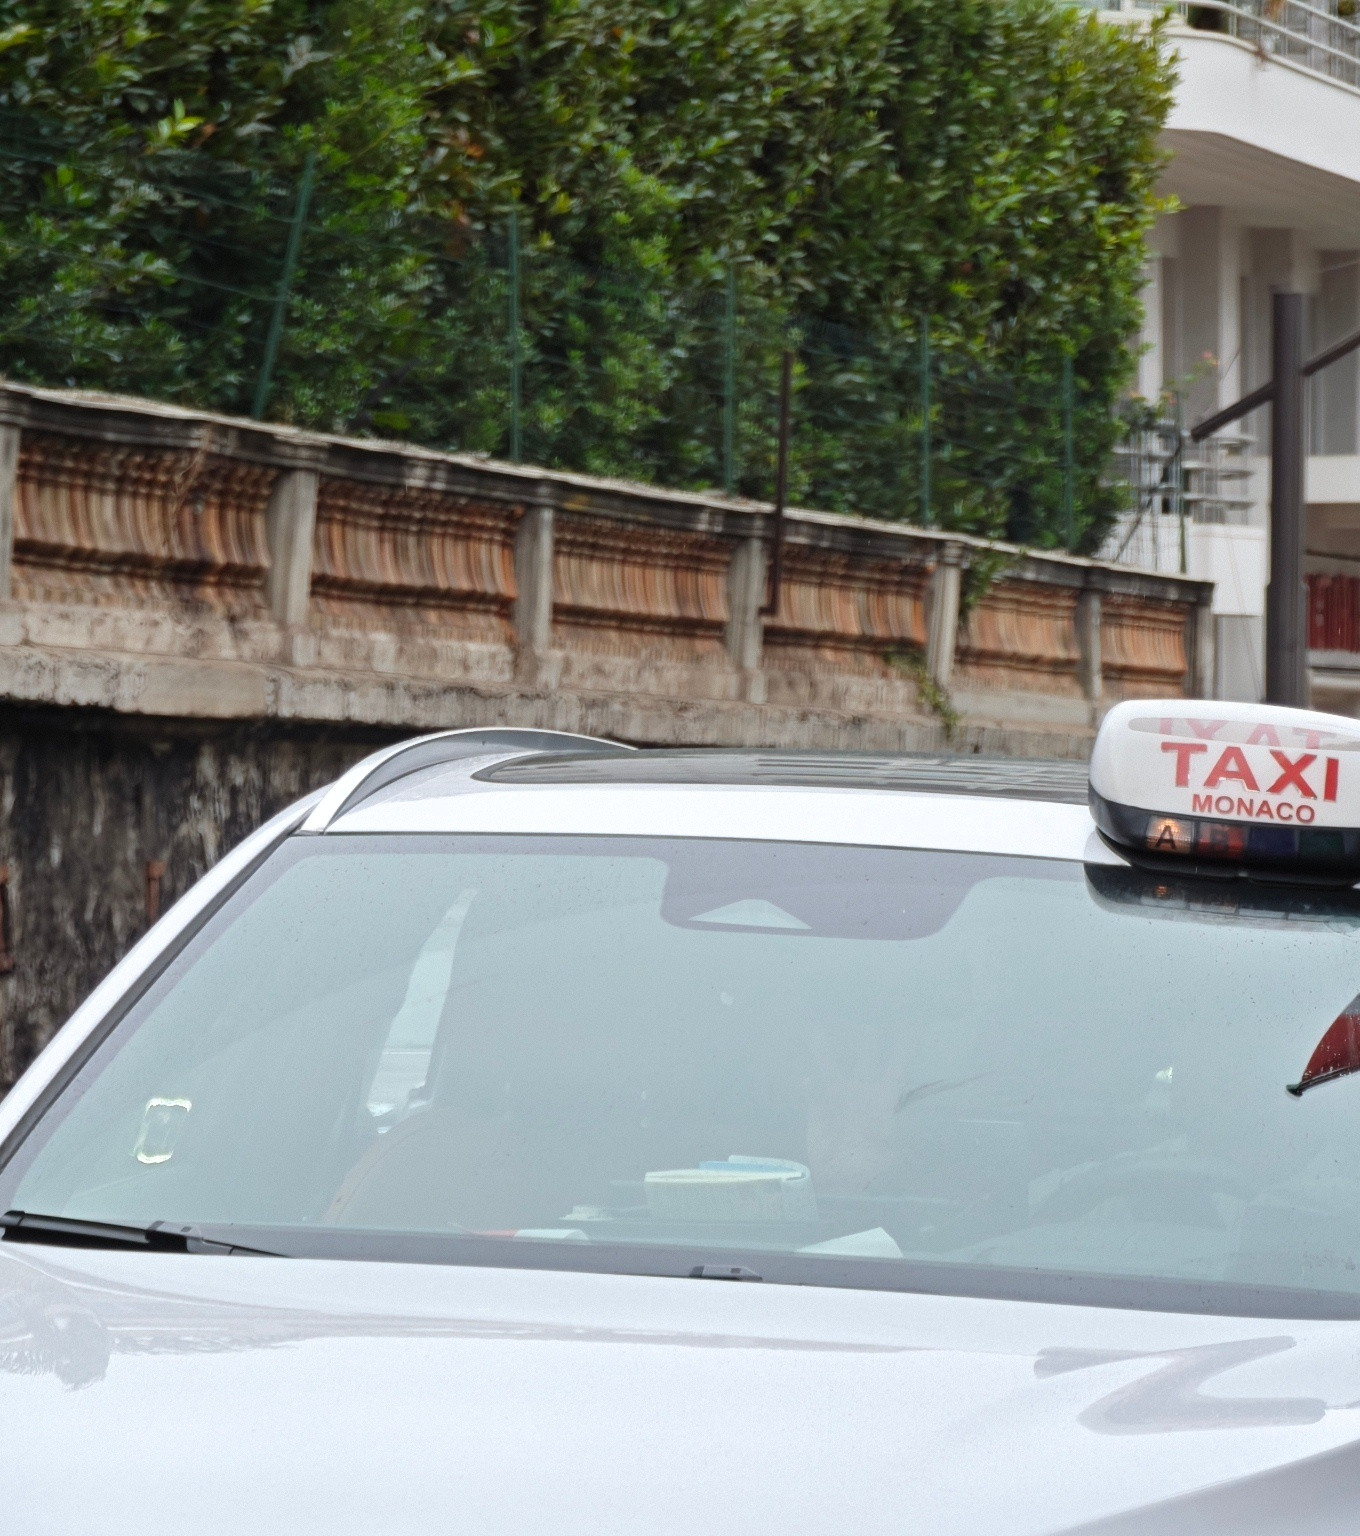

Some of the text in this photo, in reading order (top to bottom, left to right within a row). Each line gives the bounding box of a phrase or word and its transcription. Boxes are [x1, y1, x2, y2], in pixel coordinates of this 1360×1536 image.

[1160, 741, 1340, 803] TAXI
[1191, 793, 1316, 824] MONACO
[1155, 824, 1176, 850] A
